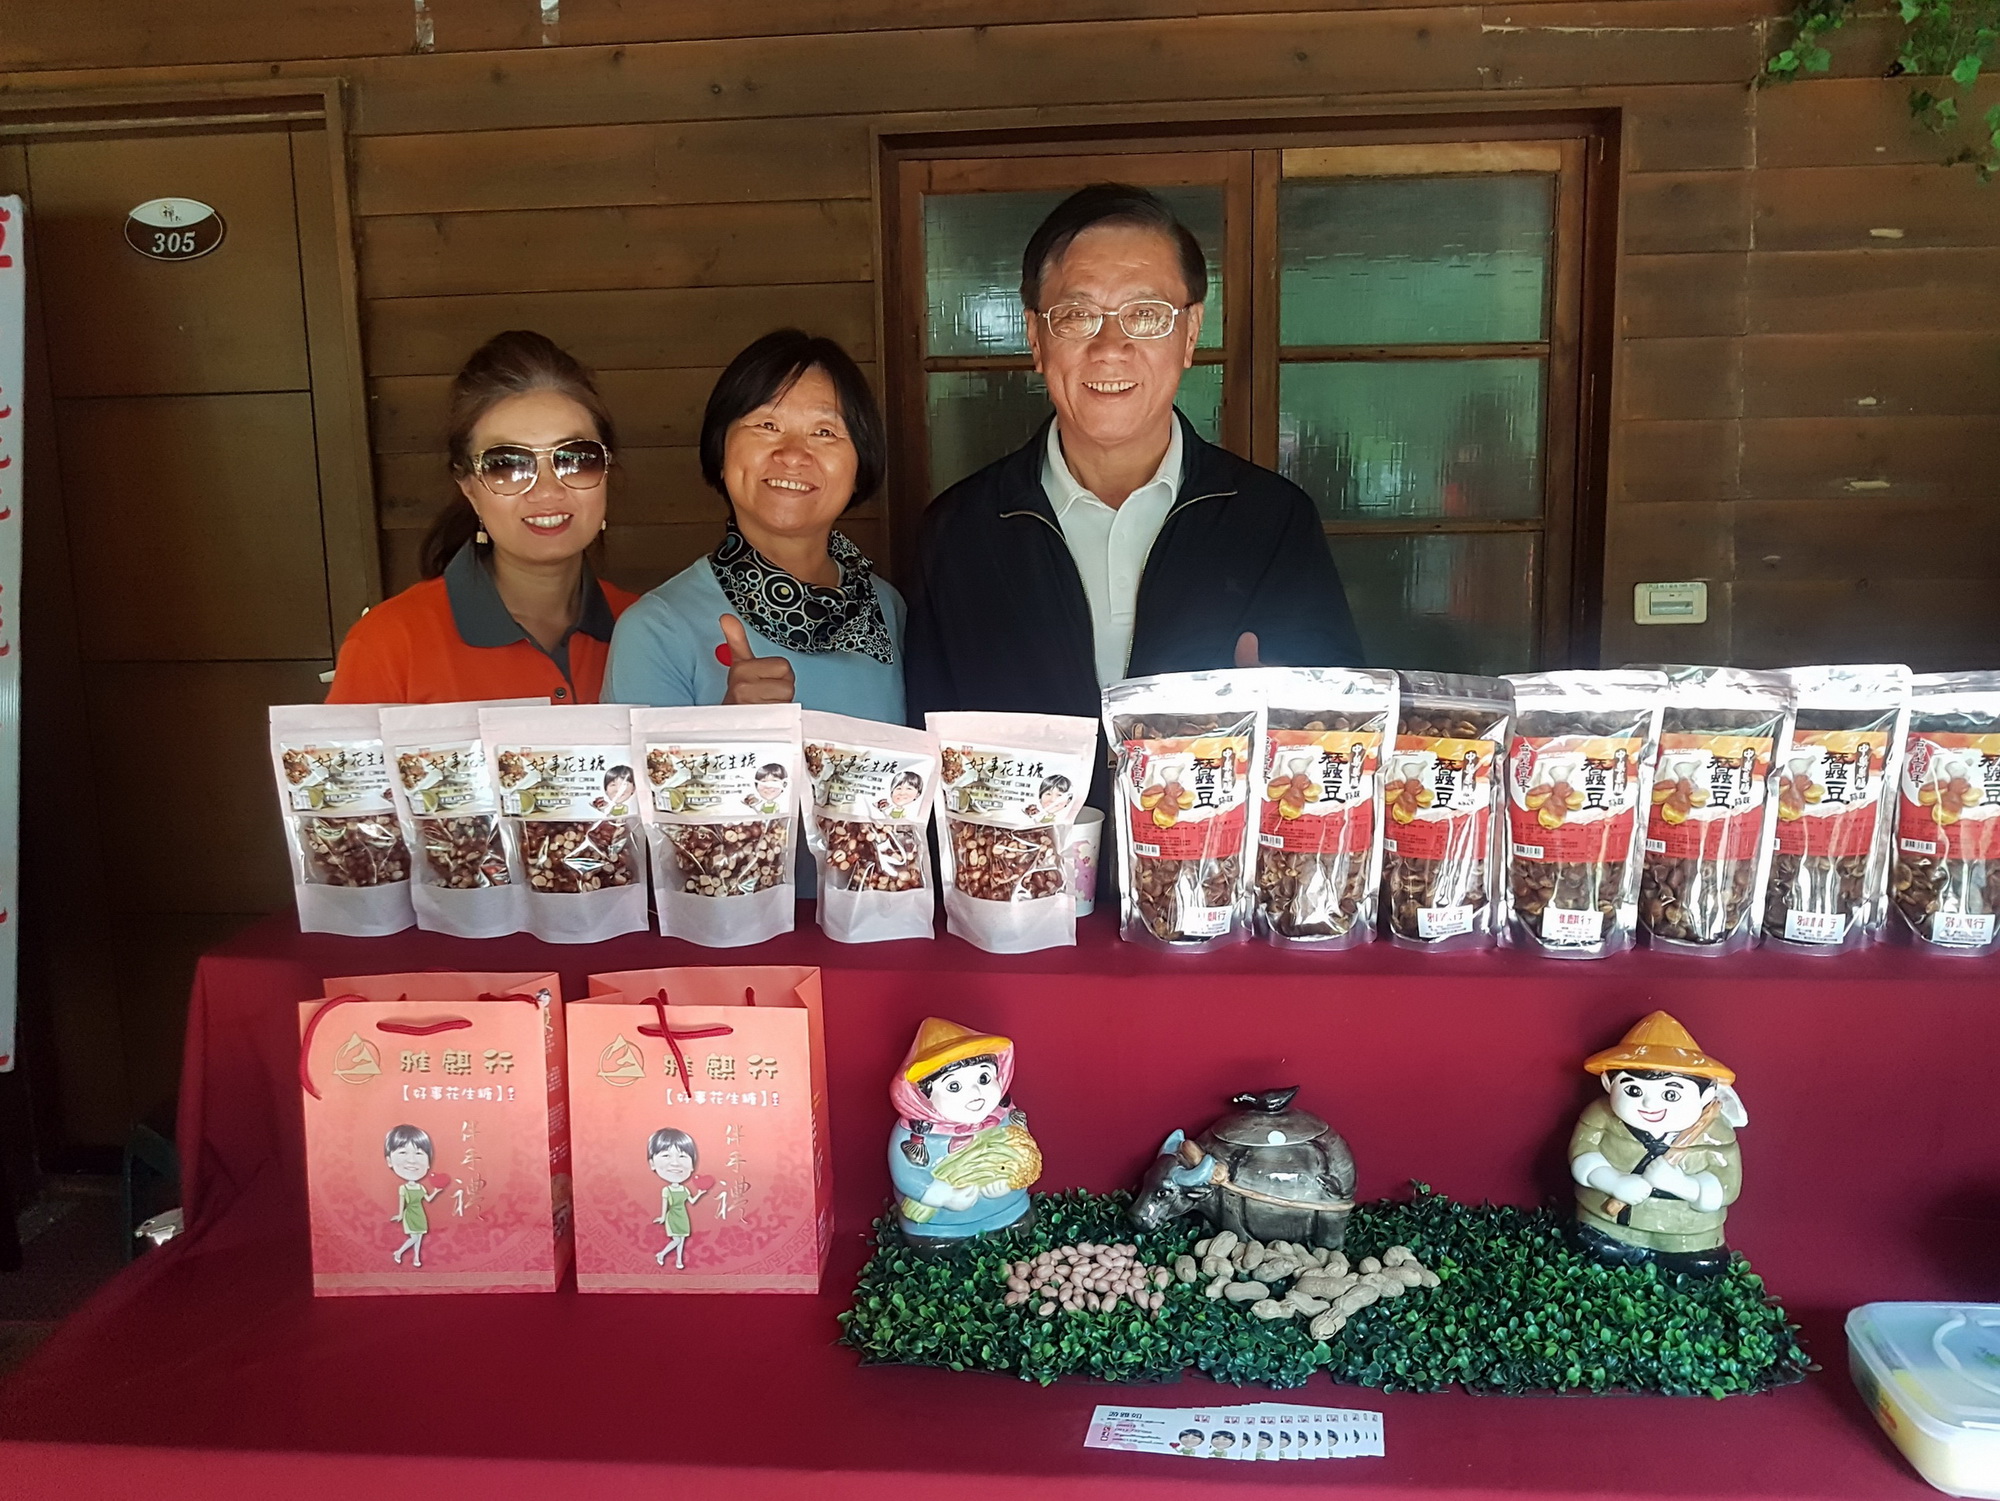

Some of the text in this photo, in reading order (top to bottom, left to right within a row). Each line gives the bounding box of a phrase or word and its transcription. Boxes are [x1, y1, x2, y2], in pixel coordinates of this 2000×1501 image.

[152, 231, 196, 253] 305
[526, 754, 606, 777] 好事花生糖
[965, 756, 1044, 779] 好事花生糖
[1190, 758, 1220, 809] 蠶豆
[1318, 752, 1348, 803] 蠶豆
[1431, 758, 1462, 811] 蠶豆
[1581, 758, 1612, 810] 蠶豆
[1707, 756, 1735, 809] 蠶豆
[1821, 752, 1854, 804] 蠶豆
[400, 1047, 515, 1076] 雅麒行
